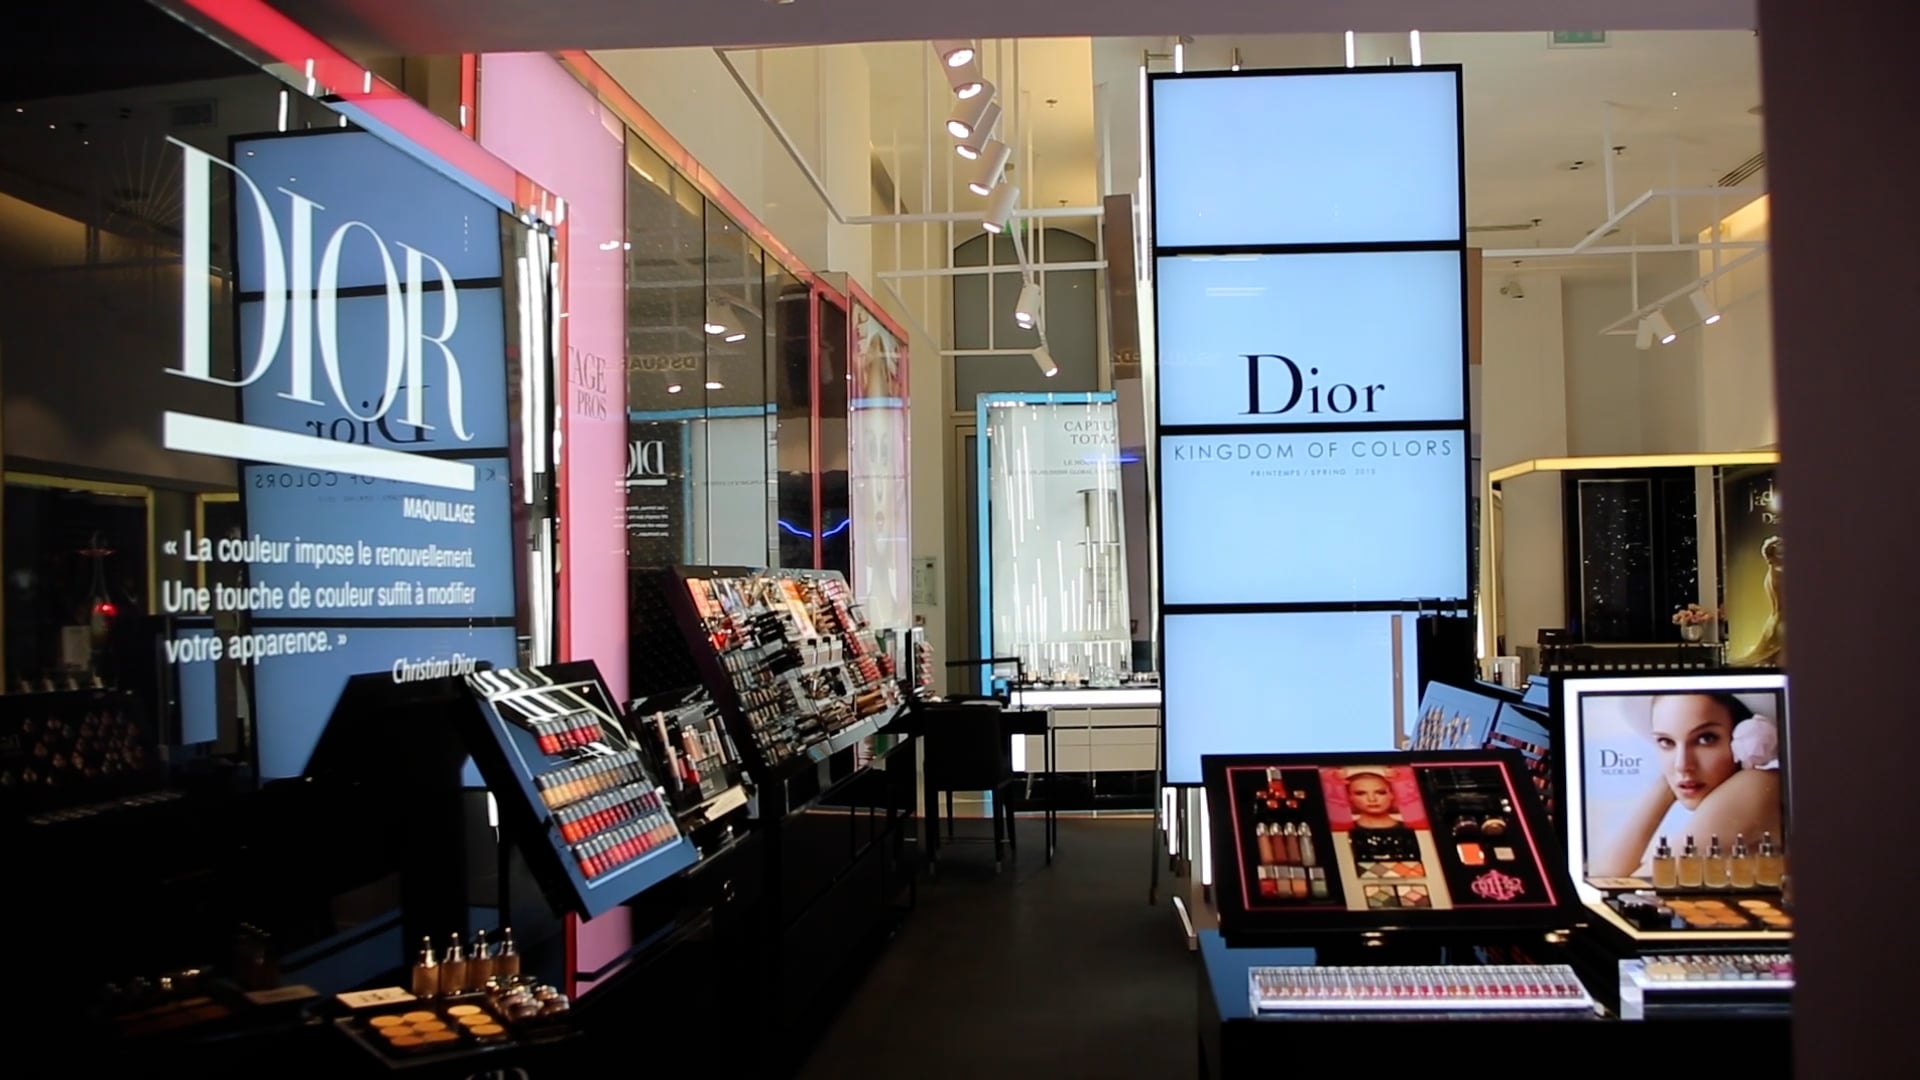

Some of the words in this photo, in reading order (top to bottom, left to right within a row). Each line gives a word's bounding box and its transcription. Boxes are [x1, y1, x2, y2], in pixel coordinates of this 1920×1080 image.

[164, 135, 474, 441] DIOR
[1238, 353, 1385, 415] Dior
[577, 390, 607, 420] PROS
[1174, 444, 1294, 461] KINGDOM
[1307, 442, 1338, 459] OF
[1351, 440, 1451, 458] COLORS
[1250, 470, 1301, 478] PRINTEMPS
[403, 497, 476, 524] MAQUILLAGE
[184, 530, 213, 562] La
[218, 533, 290, 563] couleur
[295, 536, 354, 569] impose
[358, 540, 372, 566] le
[375, 544, 476, 569] renouvellement.
[162, 580, 210, 613] Une
[215, 579, 283, 611] touche
[288, 581, 311, 609] de
[315, 581, 374, 608] couleur
[378, 580, 412, 606] suffit
[415, 581, 424, 605] à
[427, 581, 476, 605] modifier
[164, 635, 223, 664] votre
[228, 630, 333, 666] apparence.
[392, 657, 449, 685] Christian
[451, 652, 477, 676] Dior
[1600, 749, 1643, 768] Dior
